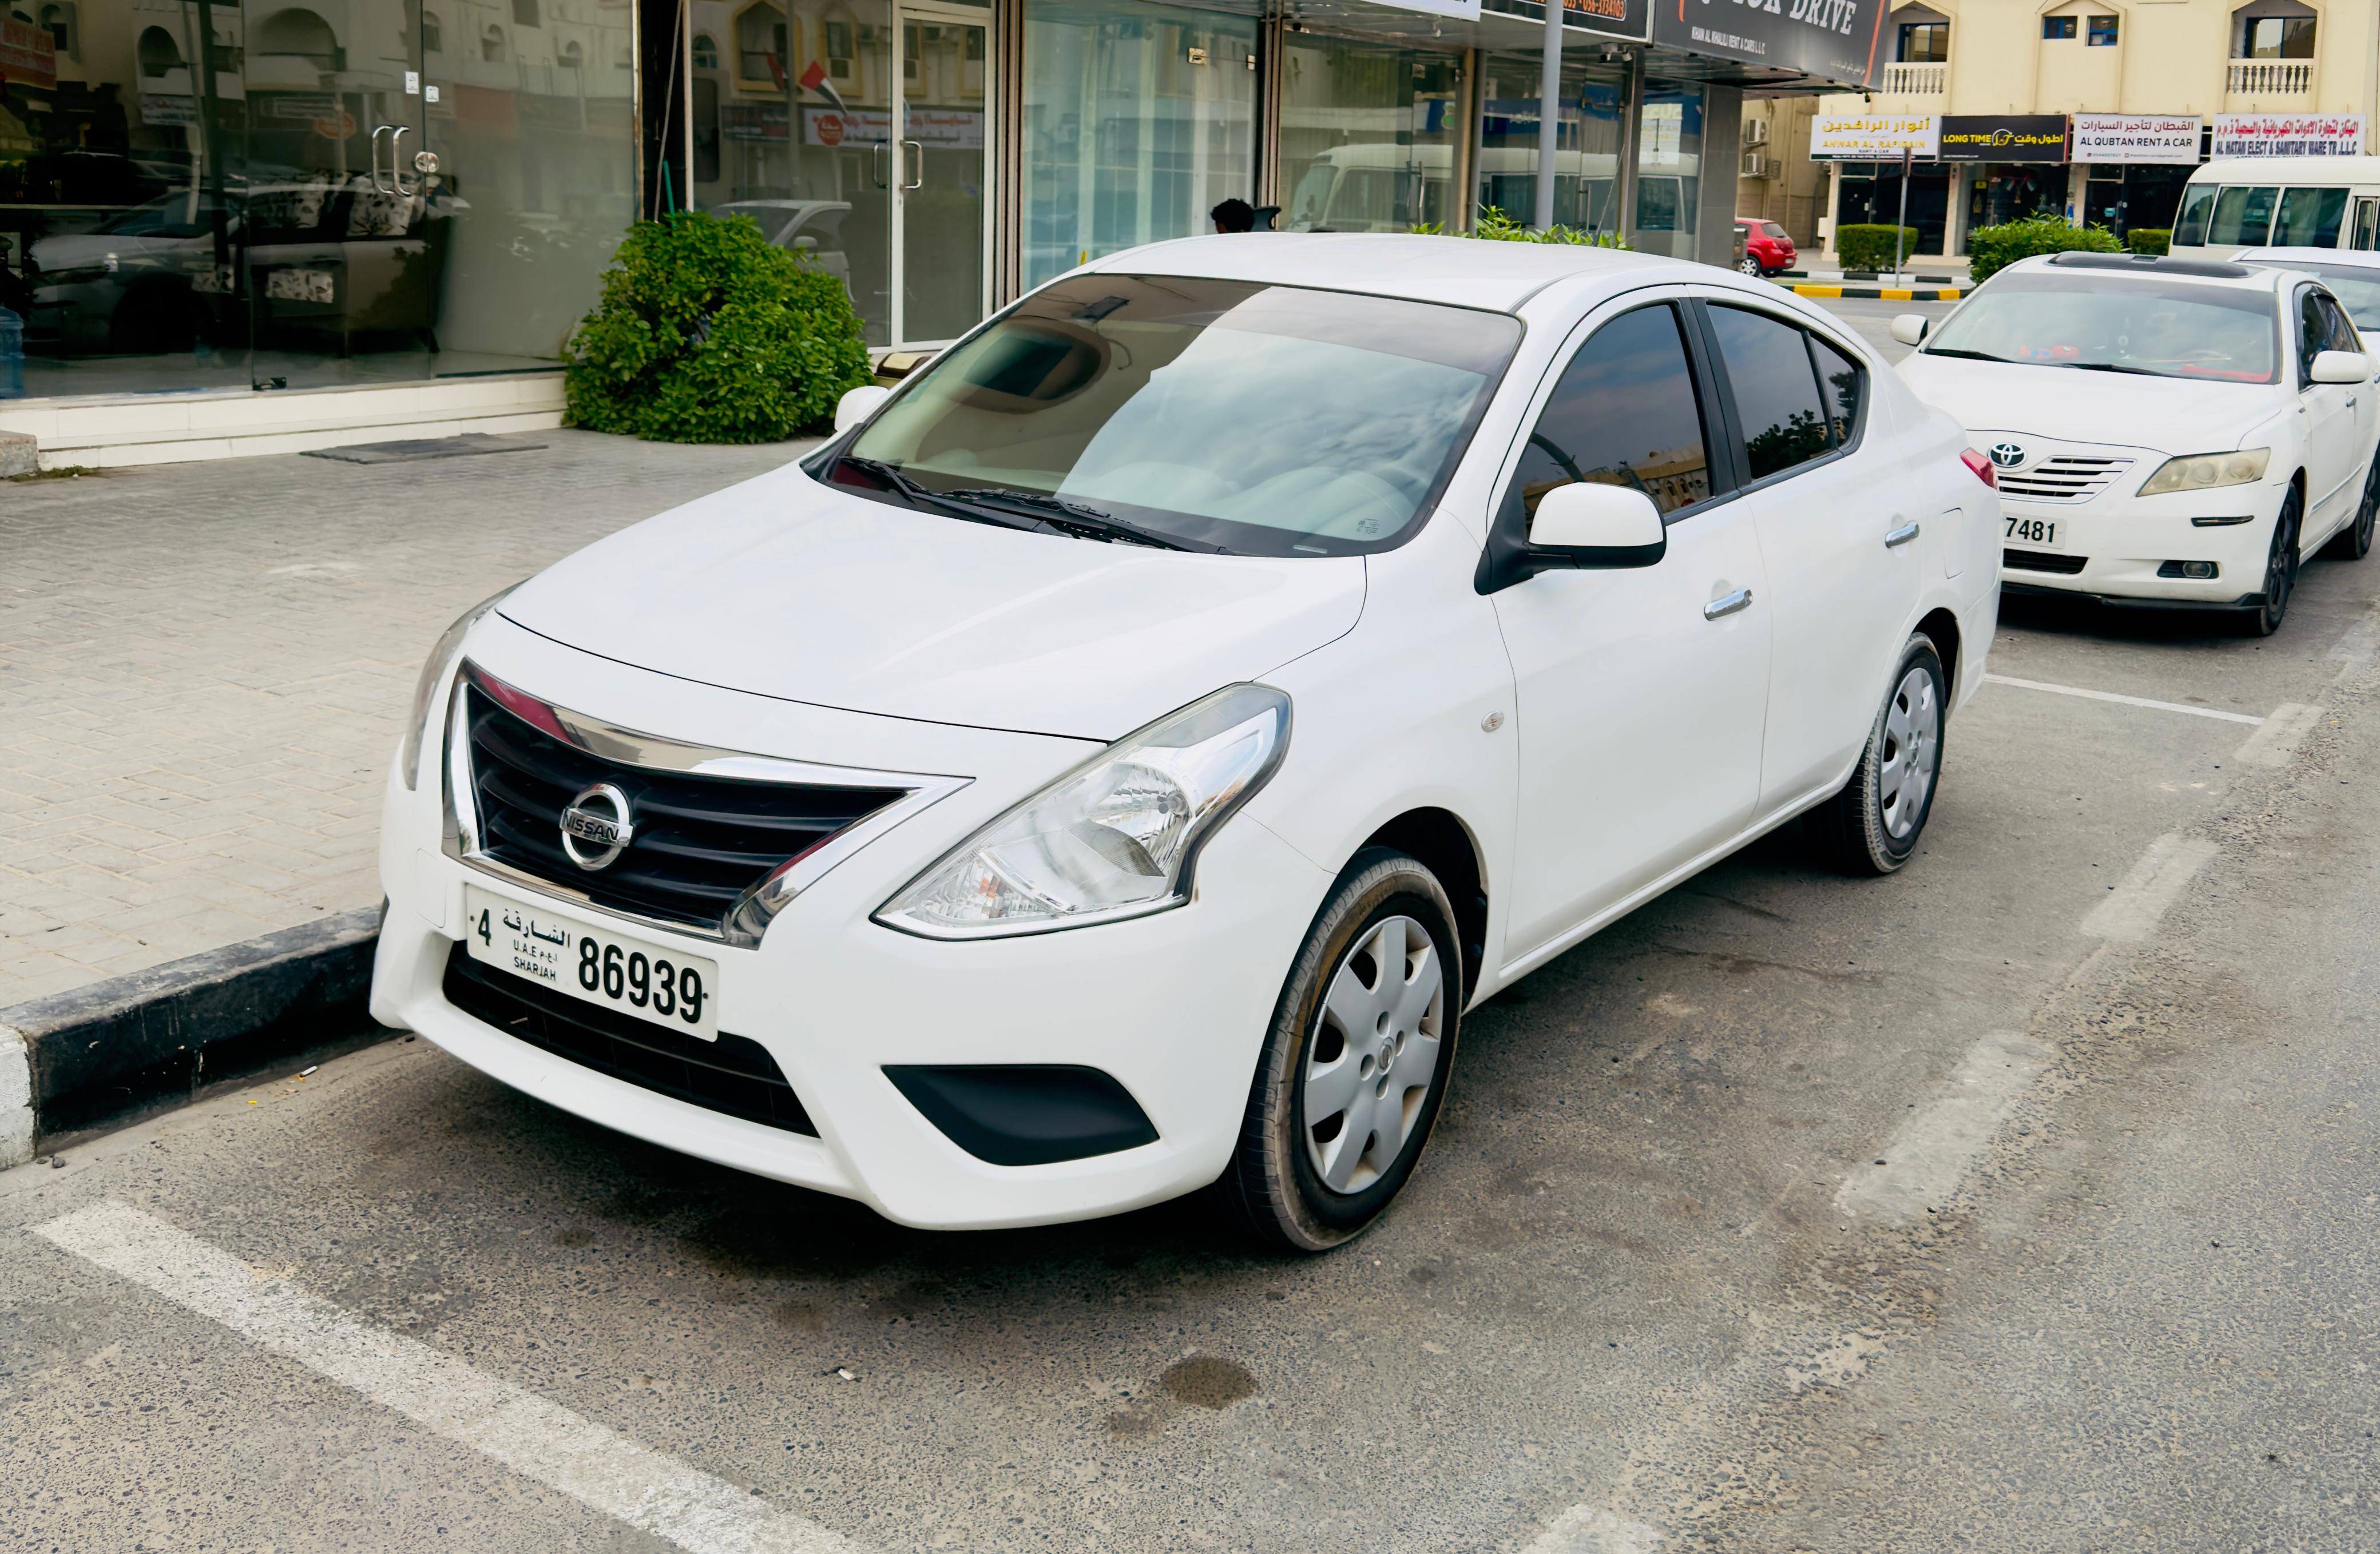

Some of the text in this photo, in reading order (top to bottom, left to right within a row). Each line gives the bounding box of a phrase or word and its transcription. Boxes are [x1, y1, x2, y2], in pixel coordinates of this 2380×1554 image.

[1789, 0, 1857, 35] DRIVE
[1943, 134, 1969, 143] LONG
[1970, 134, 1992, 143] TIME
[2014, 134, 2064, 144] اطول وقت
[2081, 119, 2194, 133] القبطان لتأجير السيارات
[2080, 137, 2193, 147] AL QUBTAN RENT A CAR
[2215, 141, 2224, 155] AL
[2247, 141, 2268, 155] ELECT
[2268, 141, 2274, 155] &
[2275, 141, 2307, 155] SANITARY
[2308, 141, 2327, 155] WARE
[2006, 516, 2056, 543] 7481
[564, 808, 620, 841] NISSAN
[478, 908, 492, 947] 4
[503, 908, 570, 949] الشارقة
[514, 956, 556, 982] SHARJAH
[578, 936, 703, 1024] 86939
